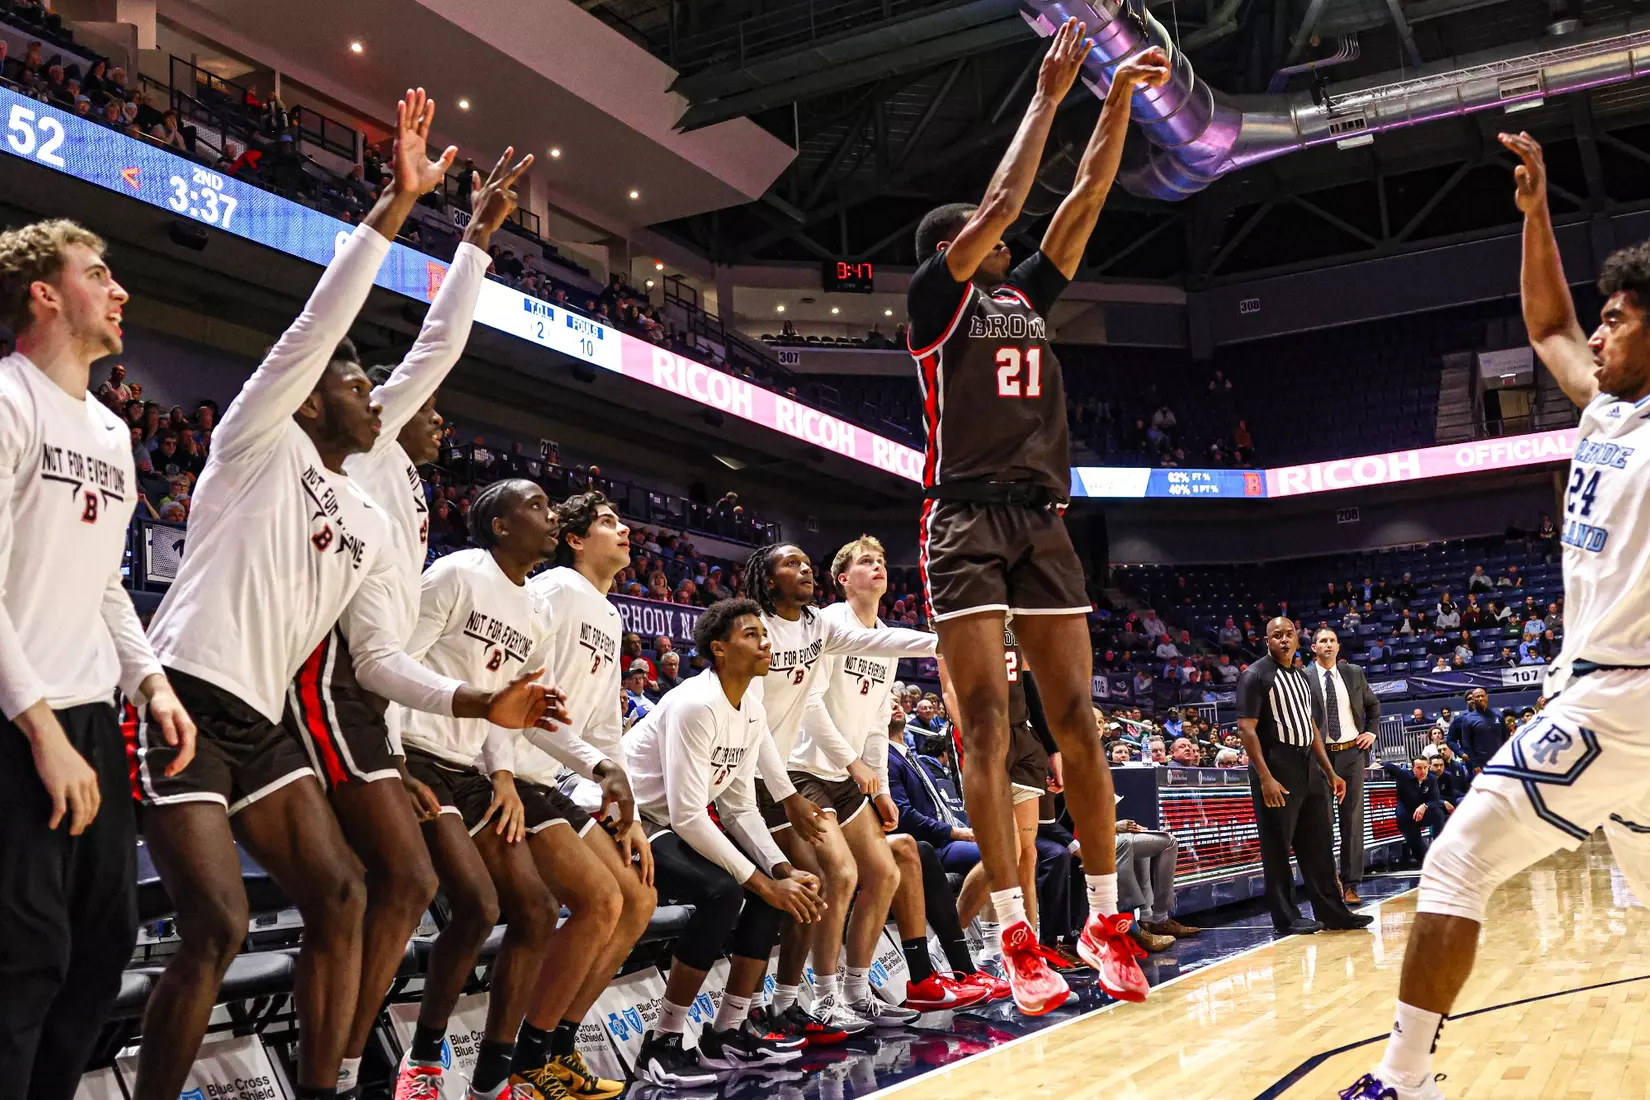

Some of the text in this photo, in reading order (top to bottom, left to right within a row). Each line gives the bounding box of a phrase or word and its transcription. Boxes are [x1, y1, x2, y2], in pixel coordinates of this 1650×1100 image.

[7, 104, 65, 168] 52
[192, 167, 224, 192] 2ND
[169, 175, 238, 229] 3:37
[1240, 300, 1259, 311] 308
[537, 321, 544, 339] 2
[572, 317, 600, 337] FOULS
[580, 338, 593, 357] 10
[780, 351, 799, 364] 307
[995, 346, 1042, 397] 21
[652, 350, 924, 481] RICOH RICOH RICO
[42, 443, 125, 494] NOT FOR EVERYONE
[1278, 434, 1570, 496] RICOH OFFICIAL
[1567, 467, 1601, 516] 24
[80, 490, 98, 525] B
[311, 522, 333, 552] B
[618, 603, 674, 638] RHODY
[465, 610, 533, 658] NOT FOR EVERYONE
[580, 621, 592, 642] NOT
[592, 627, 601, 646] FOR
[485, 648, 502, 672] B
[590, 654, 601, 674] B
[783, 651, 797, 666] FOR
[844, 655, 857, 670] NOT
[858, 659, 868, 673] FOR
[792, 669, 804, 685] B
[1512, 669, 1539, 683] 107
[860, 679, 870, 696] B
[636, 1002, 652, 1013] Blue
[642, 1012, 656, 1022] Blue
[449, 1034, 470, 1046] Blue
[581, 1032, 605, 1043] Shield
[453, 1045, 474, 1057] Blue
[206, 1083, 234, 1097] Blue
[234, 1076, 270, 1091] Cross
